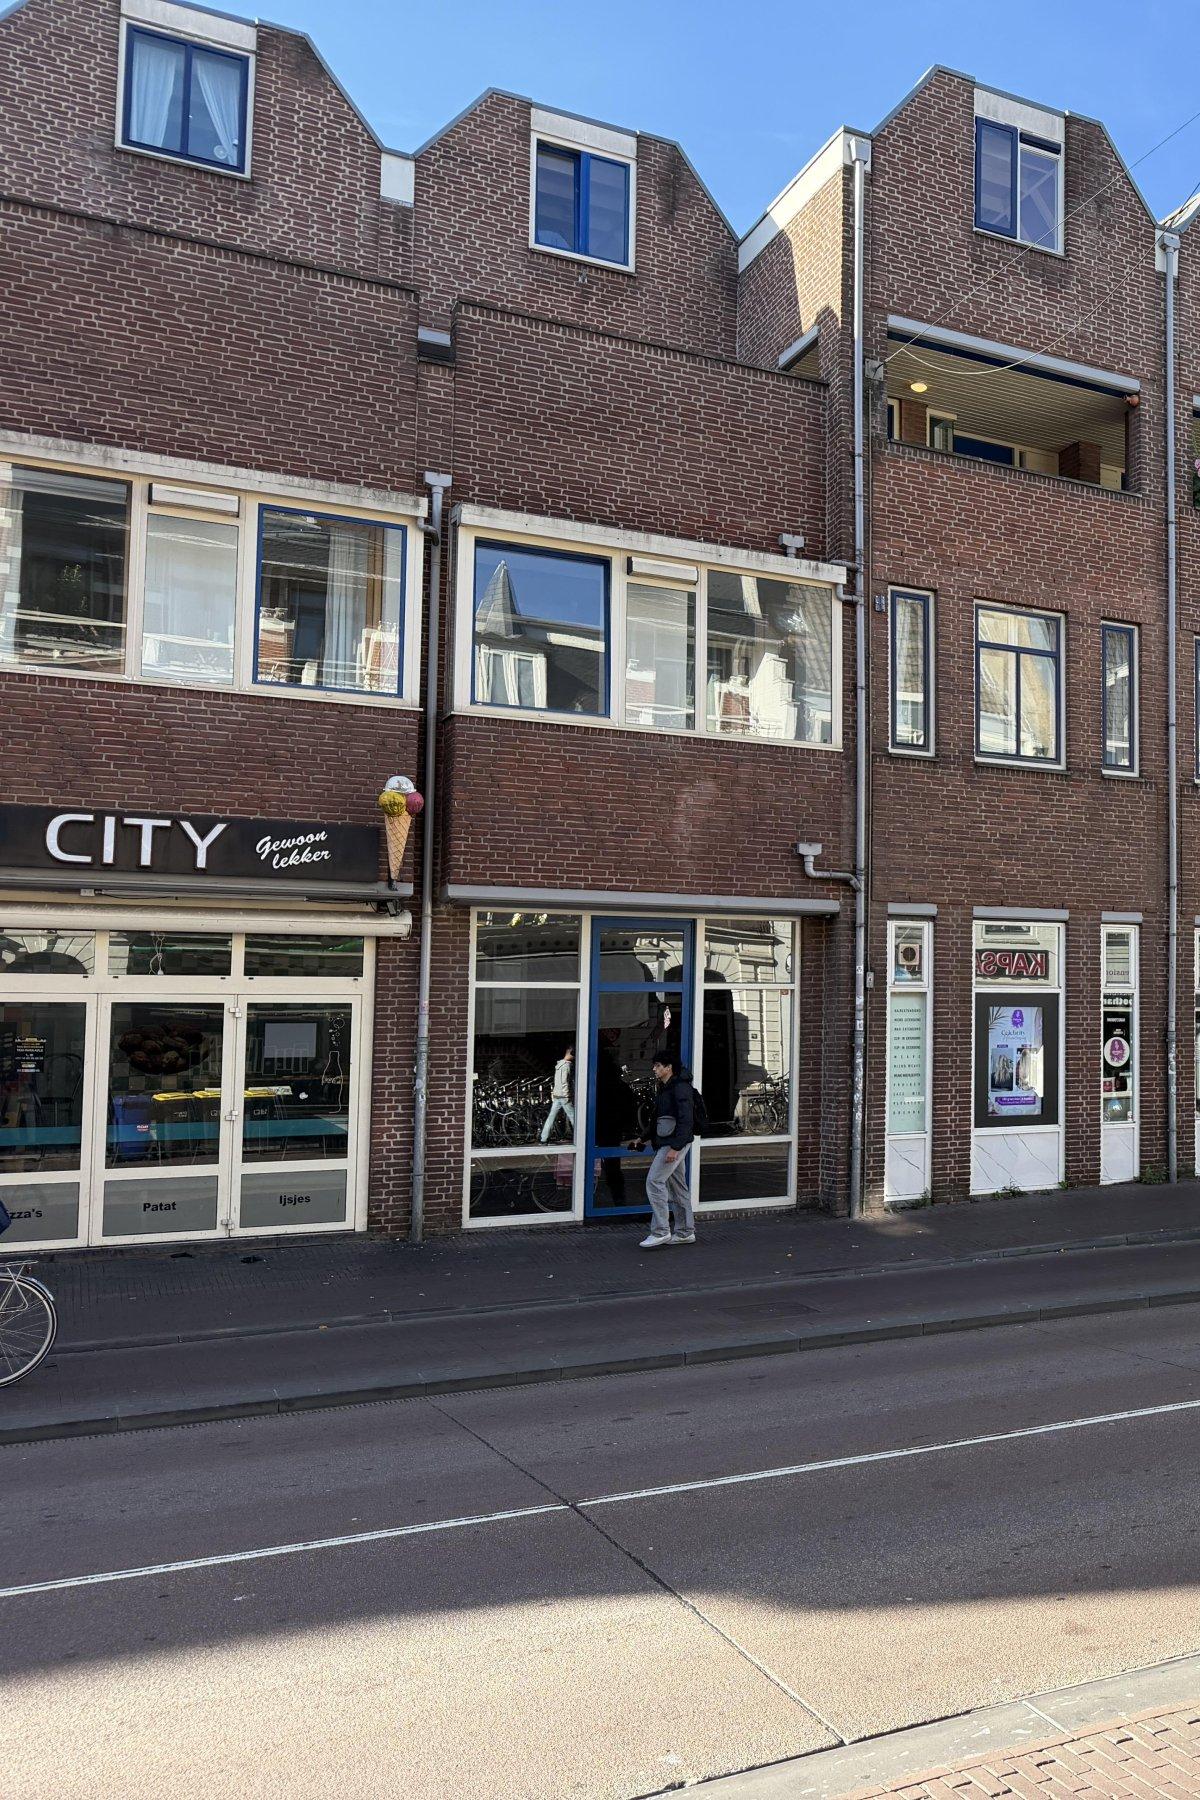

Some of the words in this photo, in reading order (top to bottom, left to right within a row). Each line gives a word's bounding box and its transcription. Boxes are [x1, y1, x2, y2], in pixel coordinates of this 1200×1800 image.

[45, 813, 228, 869] CITY
[255, 830, 328, 860] Gewoon
[272, 846, 331, 869] lekker
[142, 1200, 177, 1213] Patat
[279, 1194, 311, 1207] Ijsjes
